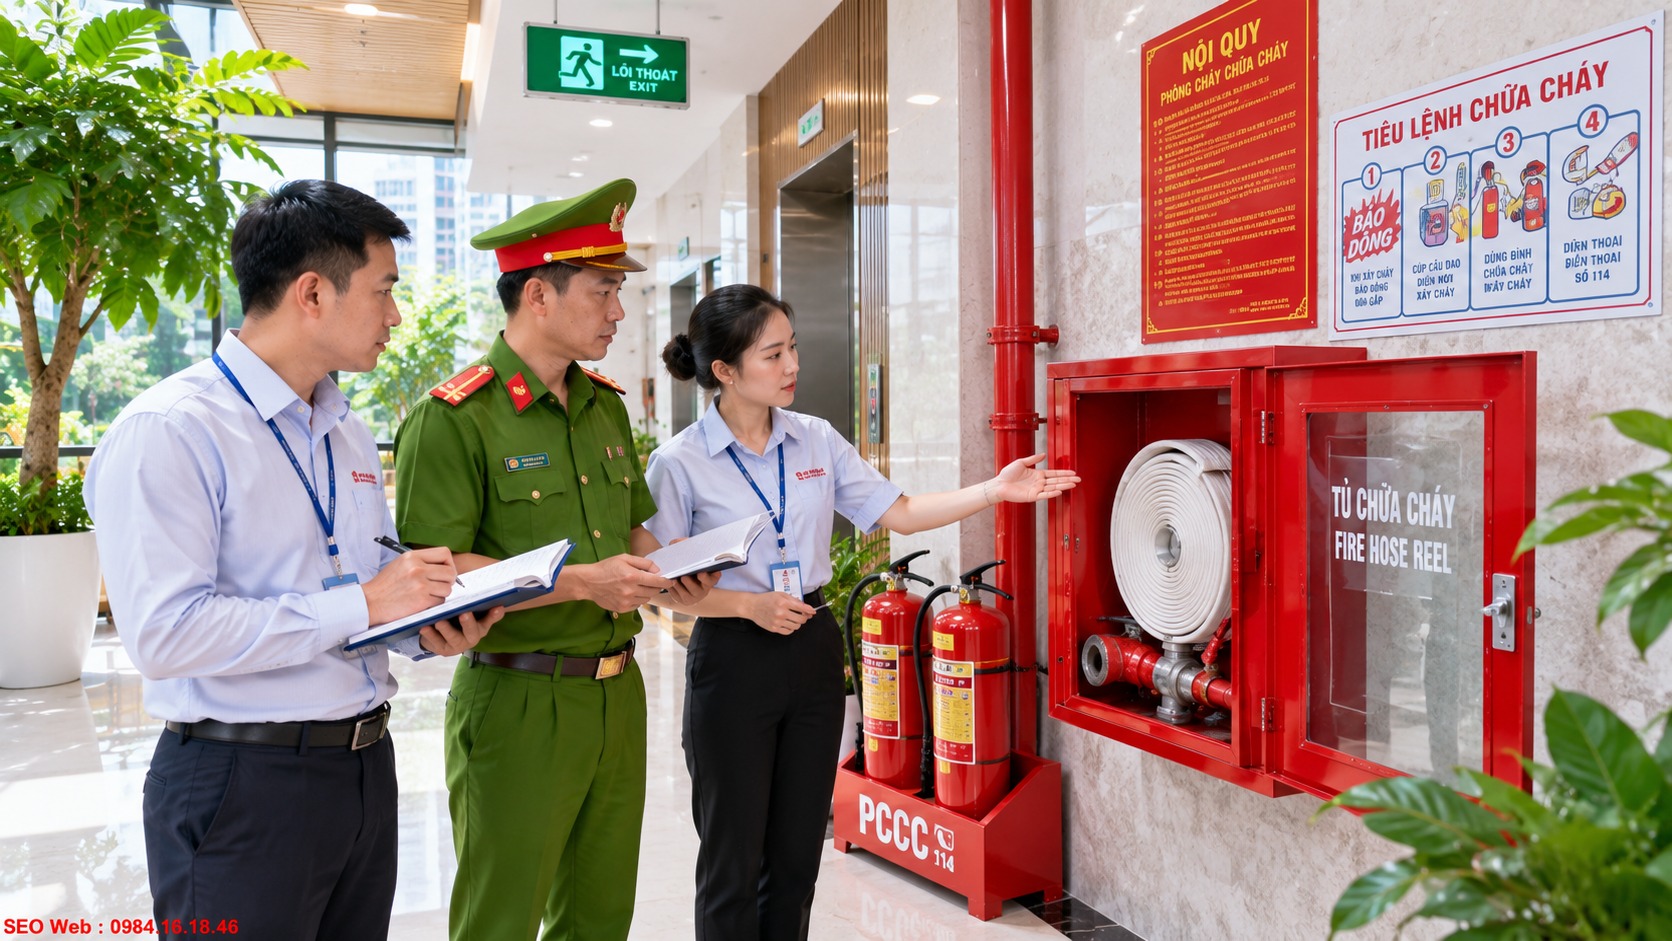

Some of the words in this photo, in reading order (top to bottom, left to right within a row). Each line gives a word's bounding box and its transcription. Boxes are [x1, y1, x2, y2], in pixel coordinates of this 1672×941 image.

[1220, 18, 1261, 58] QUY
[629, 81, 658, 93] EXIT
[1362, 119, 1404, 151] TIÊU
[1410, 104, 1462, 140] LỆNH
[1469, 83, 1532, 122] CHỮA
[1539, 60, 1609, 103] CHÁY
[1585, 110, 1600, 132] 4
[1502, 132, 1515, 153] 3
[1430, 150, 1441, 170] 2
[1368, 167, 1375, 185] 1
[1351, 203, 1386, 236] BÁO
[1445, 258, 1461, 270] DAO
[1592, 268, 1610, 282] 114
[1356, 482, 1402, 524] CHỮA
[1406, 484, 1456, 529] CHÁY
[1335, 530, 1365, 563] FIRE
[1369, 534, 1409, 569] HOSE
[1413, 538, 1452, 575] REEL
[858, 793, 929, 860] PCCC
[933, 849, 955, 873] 114
